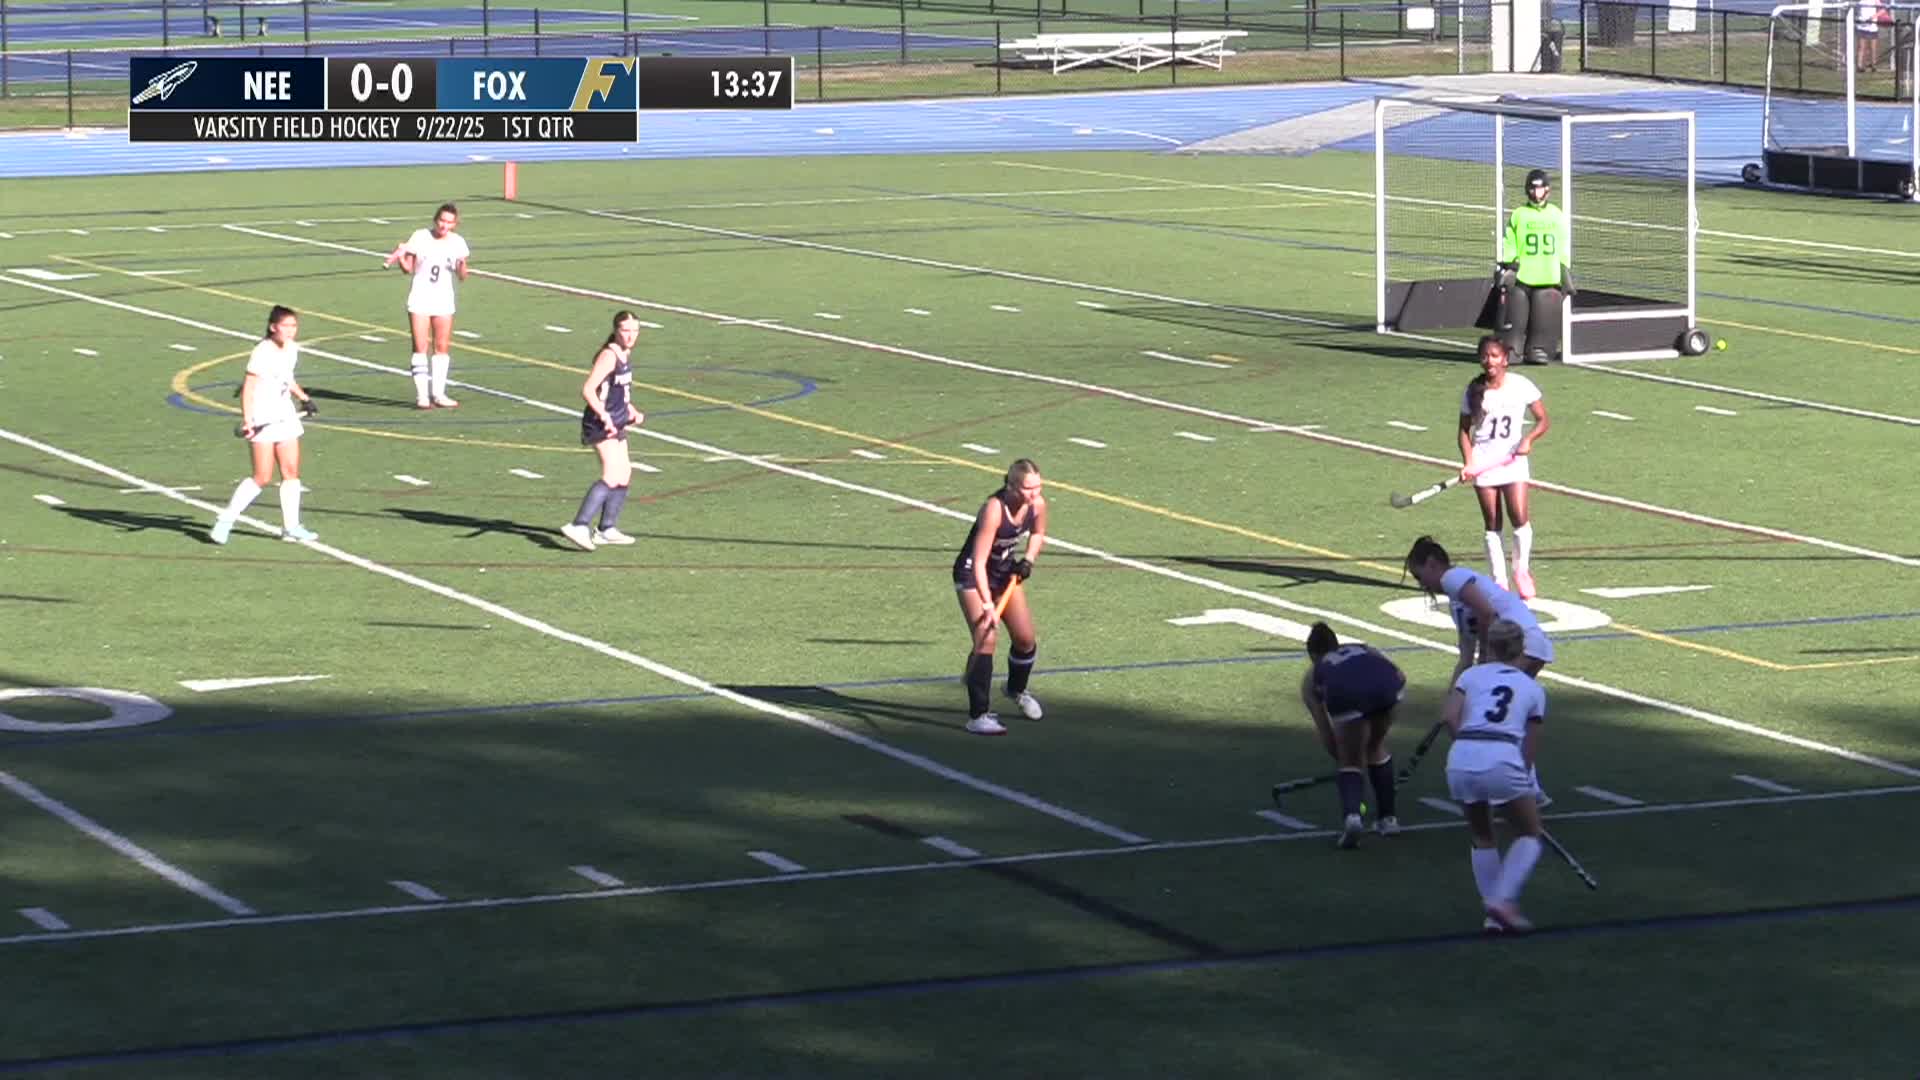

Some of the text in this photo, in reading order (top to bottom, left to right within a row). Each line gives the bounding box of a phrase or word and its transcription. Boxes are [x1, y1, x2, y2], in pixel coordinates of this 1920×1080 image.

[1526, 233, 1555, 256] 99
[429, 264, 440, 283] 9
[1489, 415, 1511, 440] 13
[1484, 685, 1514, 723] 3
